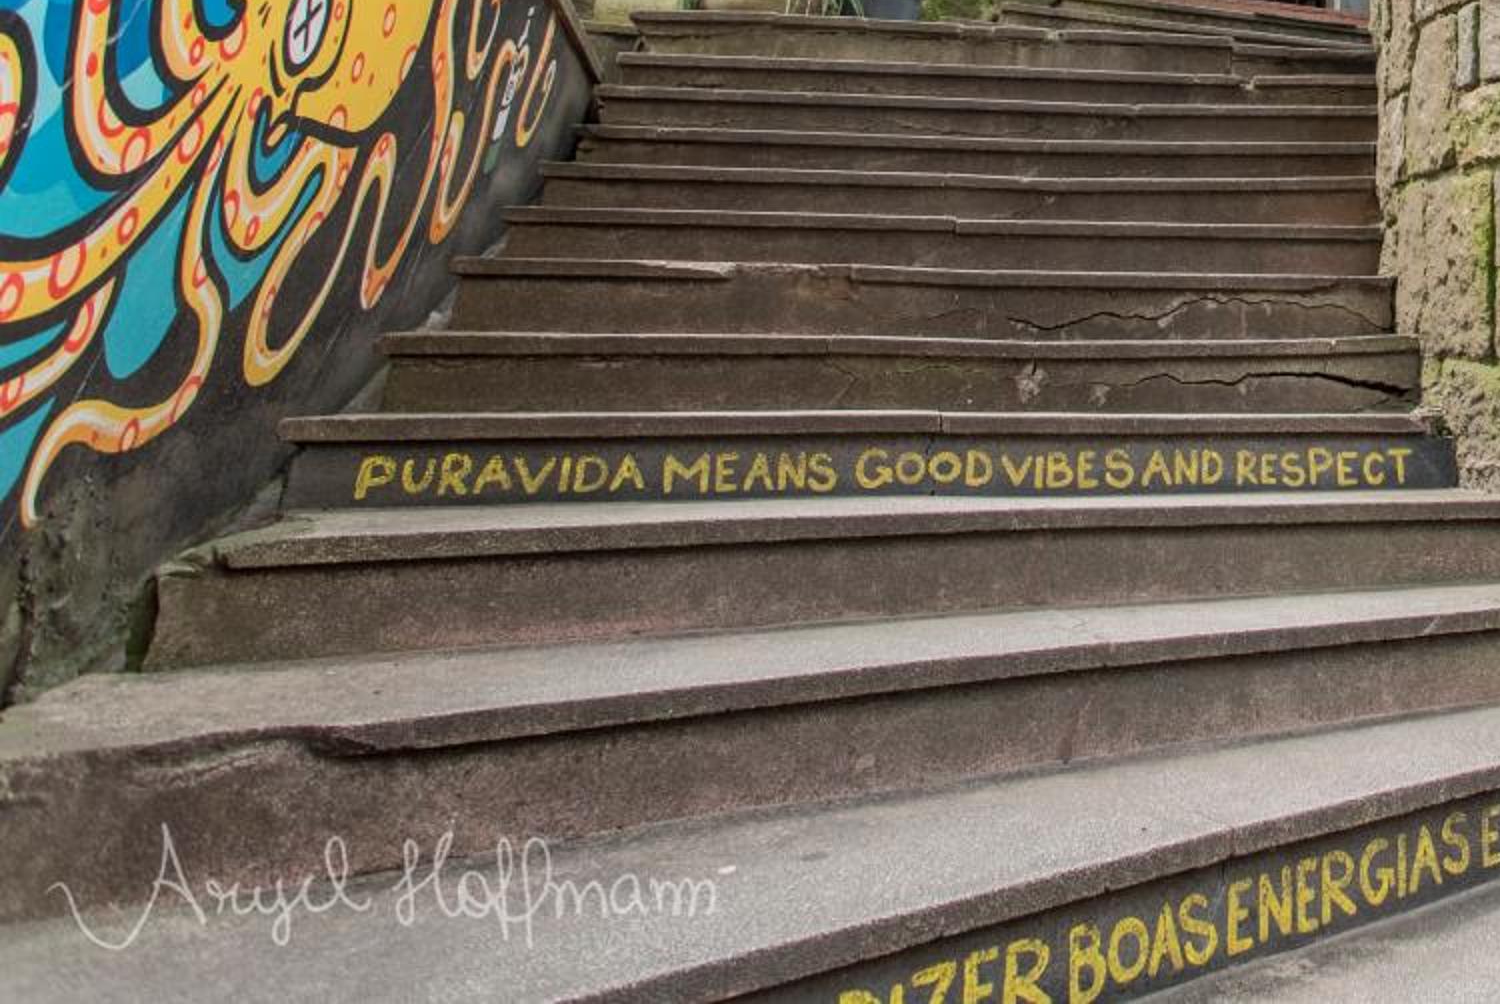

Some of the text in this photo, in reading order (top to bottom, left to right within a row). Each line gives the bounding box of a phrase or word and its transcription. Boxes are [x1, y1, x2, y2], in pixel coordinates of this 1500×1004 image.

[663, 450, 837, 494] MEANS
[855, 447, 993, 489] GOOD
[1002, 448, 1135, 488] VIBES
[1141, 448, 1221, 486] AND
[1236, 447, 1412, 486] RESPECT
[837, 938, 1052, 1004] ZER
[1069, 892, 1219, 1004] BOAS
[1226, 810, 1471, 956] ENERGIAS
